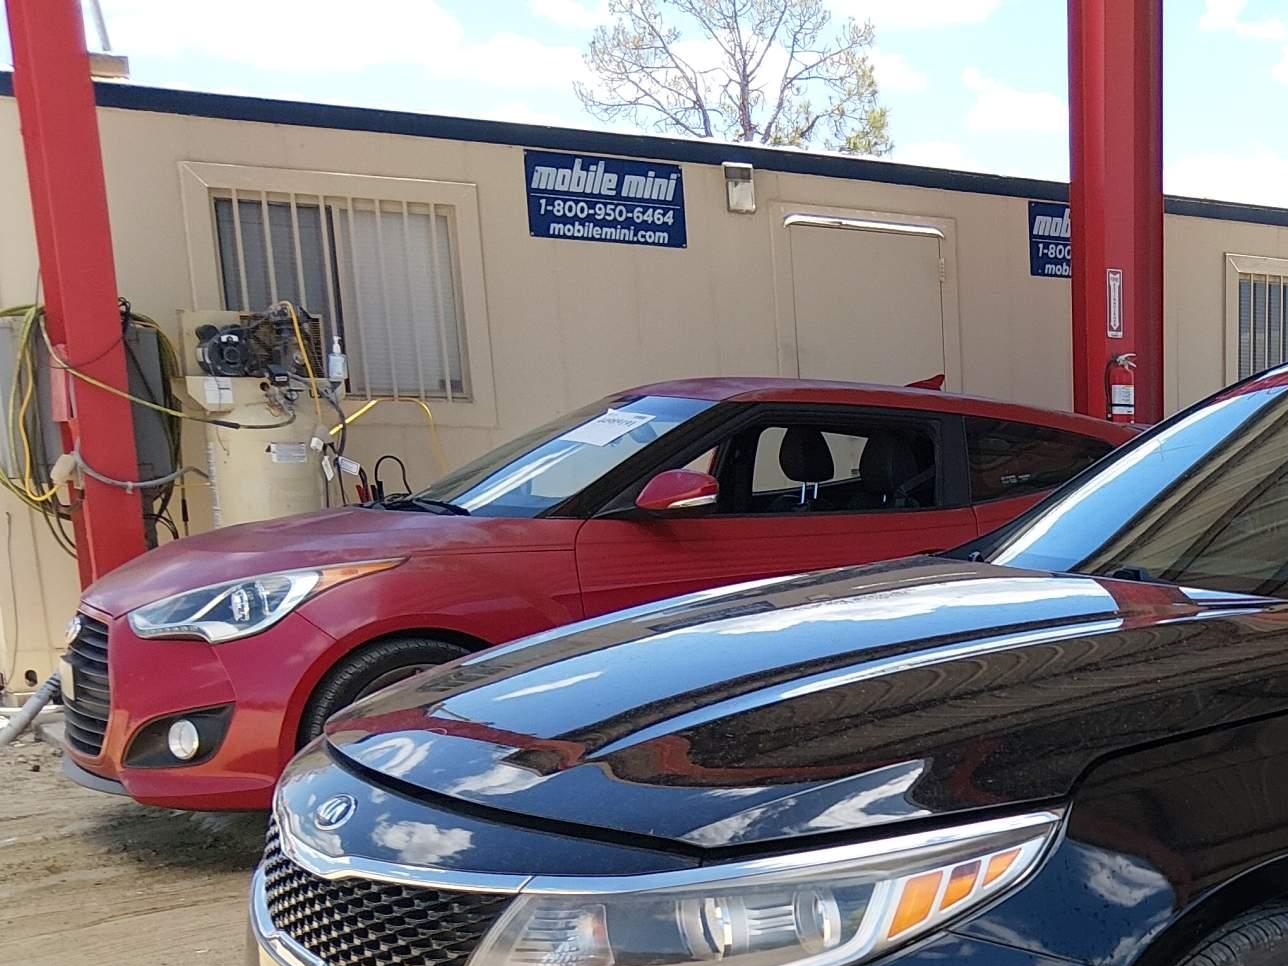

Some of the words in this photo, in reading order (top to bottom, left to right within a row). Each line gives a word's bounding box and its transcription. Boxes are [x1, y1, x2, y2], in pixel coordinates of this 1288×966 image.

[531, 158, 618, 196] mobile
[621, 171, 678, 201] mini
[539, 198, 674, 226] 1-800-950-6464
[549, 222, 669, 244] mobilemini.com
